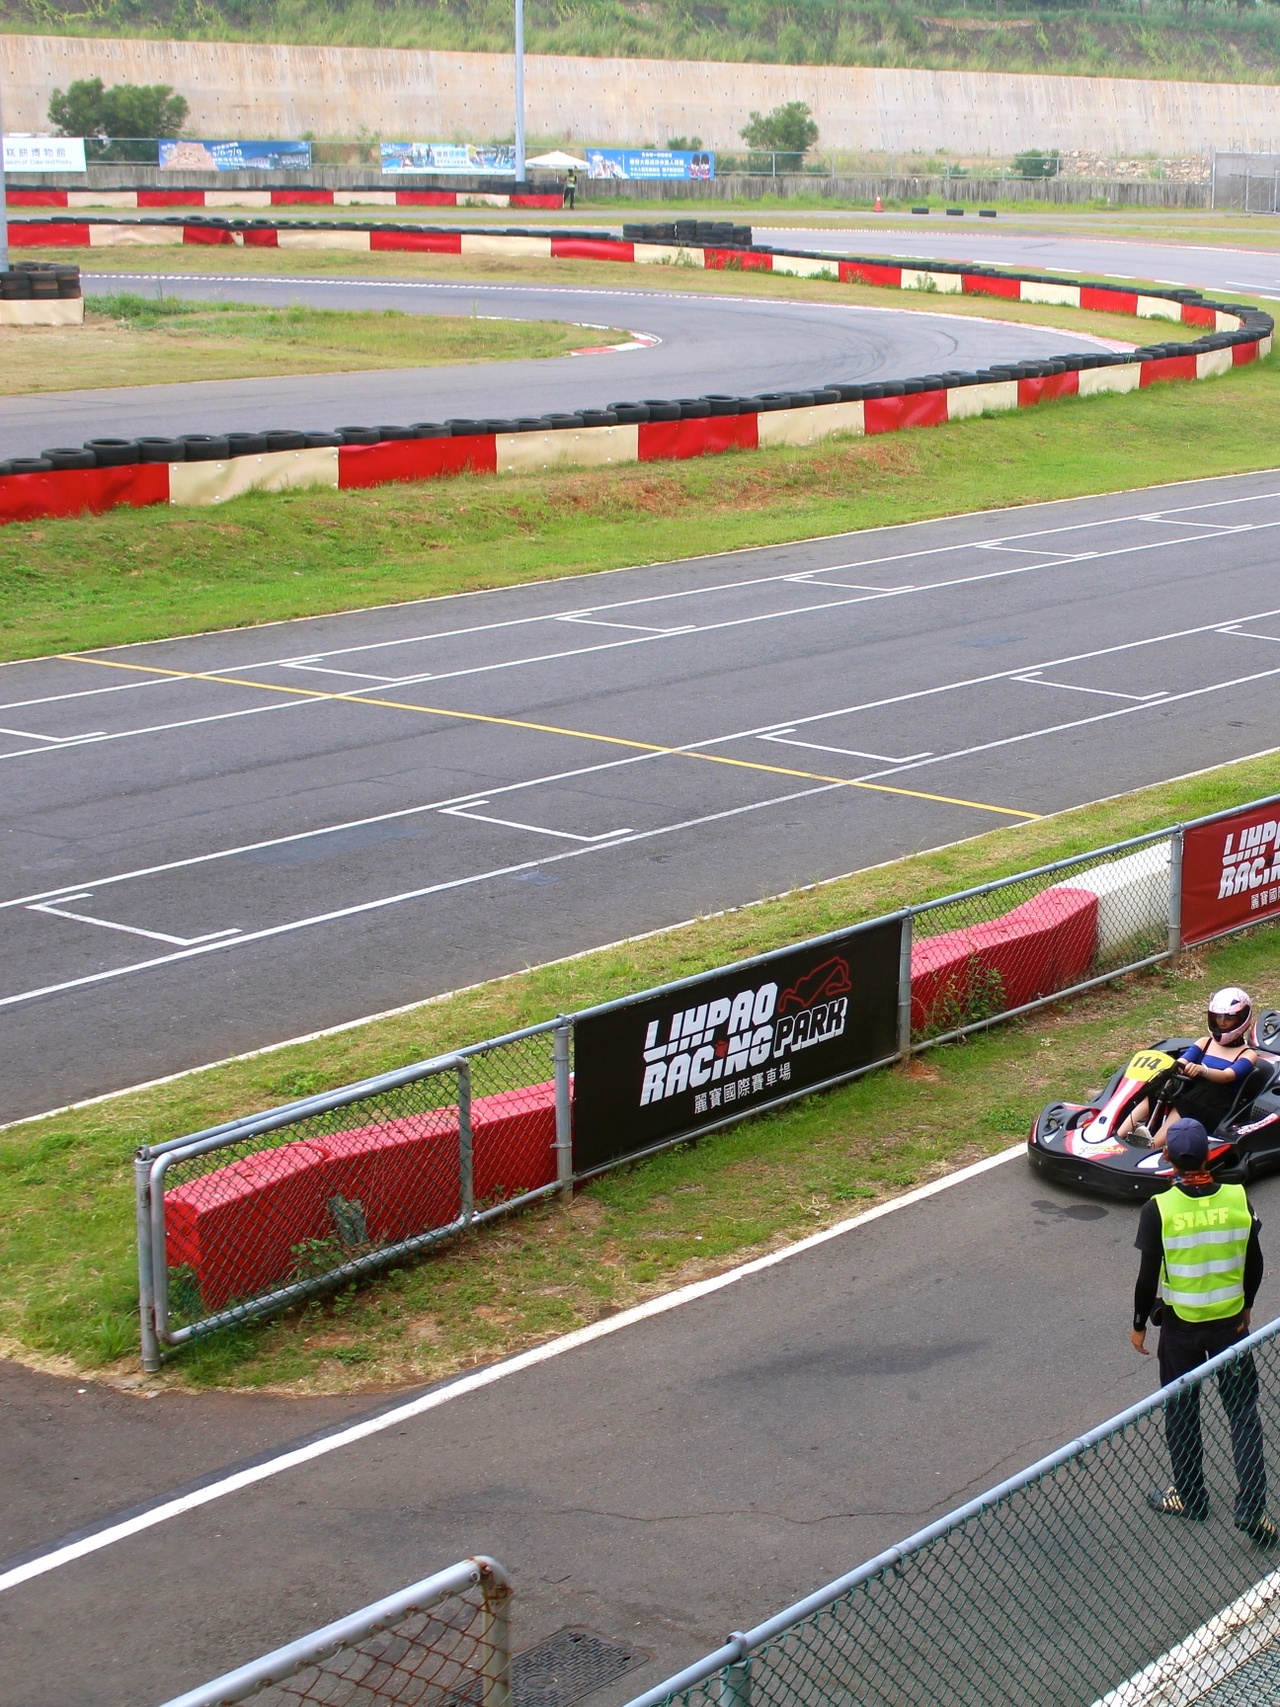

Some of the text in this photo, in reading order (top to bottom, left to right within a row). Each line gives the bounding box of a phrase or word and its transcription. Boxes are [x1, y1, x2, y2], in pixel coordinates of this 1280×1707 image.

[643, 982, 778, 1062] LIHPAO
[640, 997, 848, 1107] RACING PARK
[1133, 1055, 1162, 1070] 114
[694, 1062, 792, 1114] 麗寶國際賽車場
[1172, 1207, 1229, 1231] STAFF
